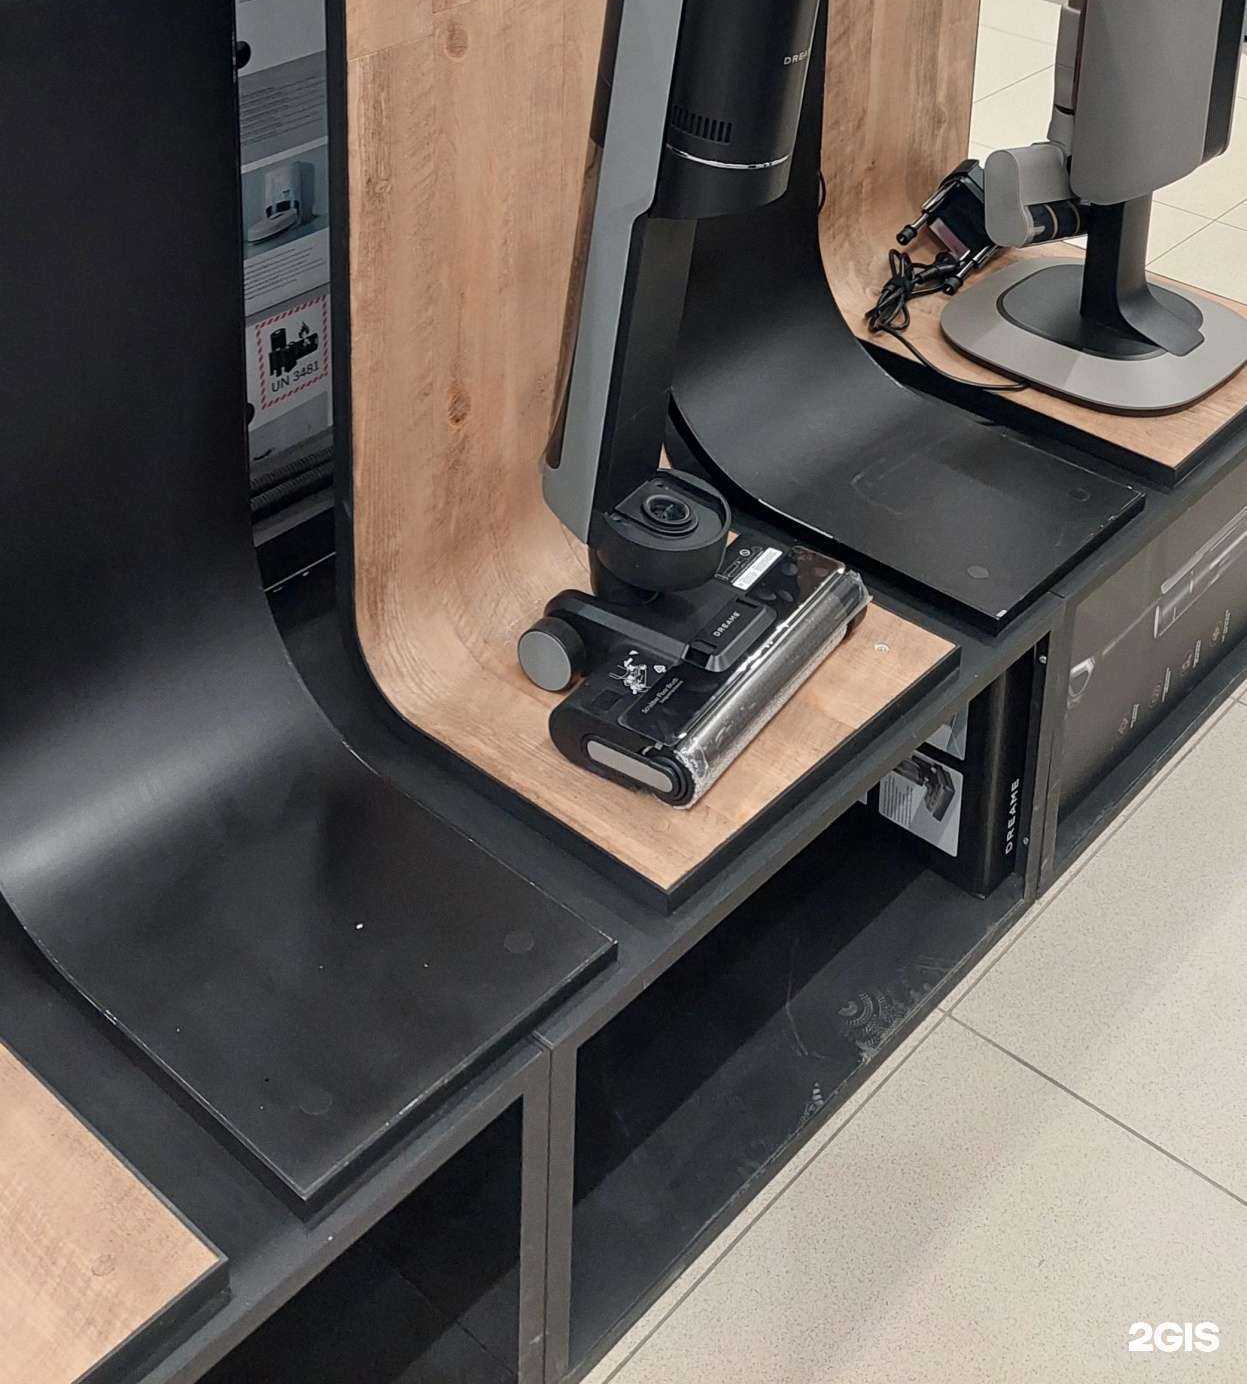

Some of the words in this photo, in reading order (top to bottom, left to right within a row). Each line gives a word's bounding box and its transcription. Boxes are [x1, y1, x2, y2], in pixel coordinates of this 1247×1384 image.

[271, 375, 290, 392] UN
[293, 361, 320, 381] 3481
[1004, 778, 1020, 856] DREAME
